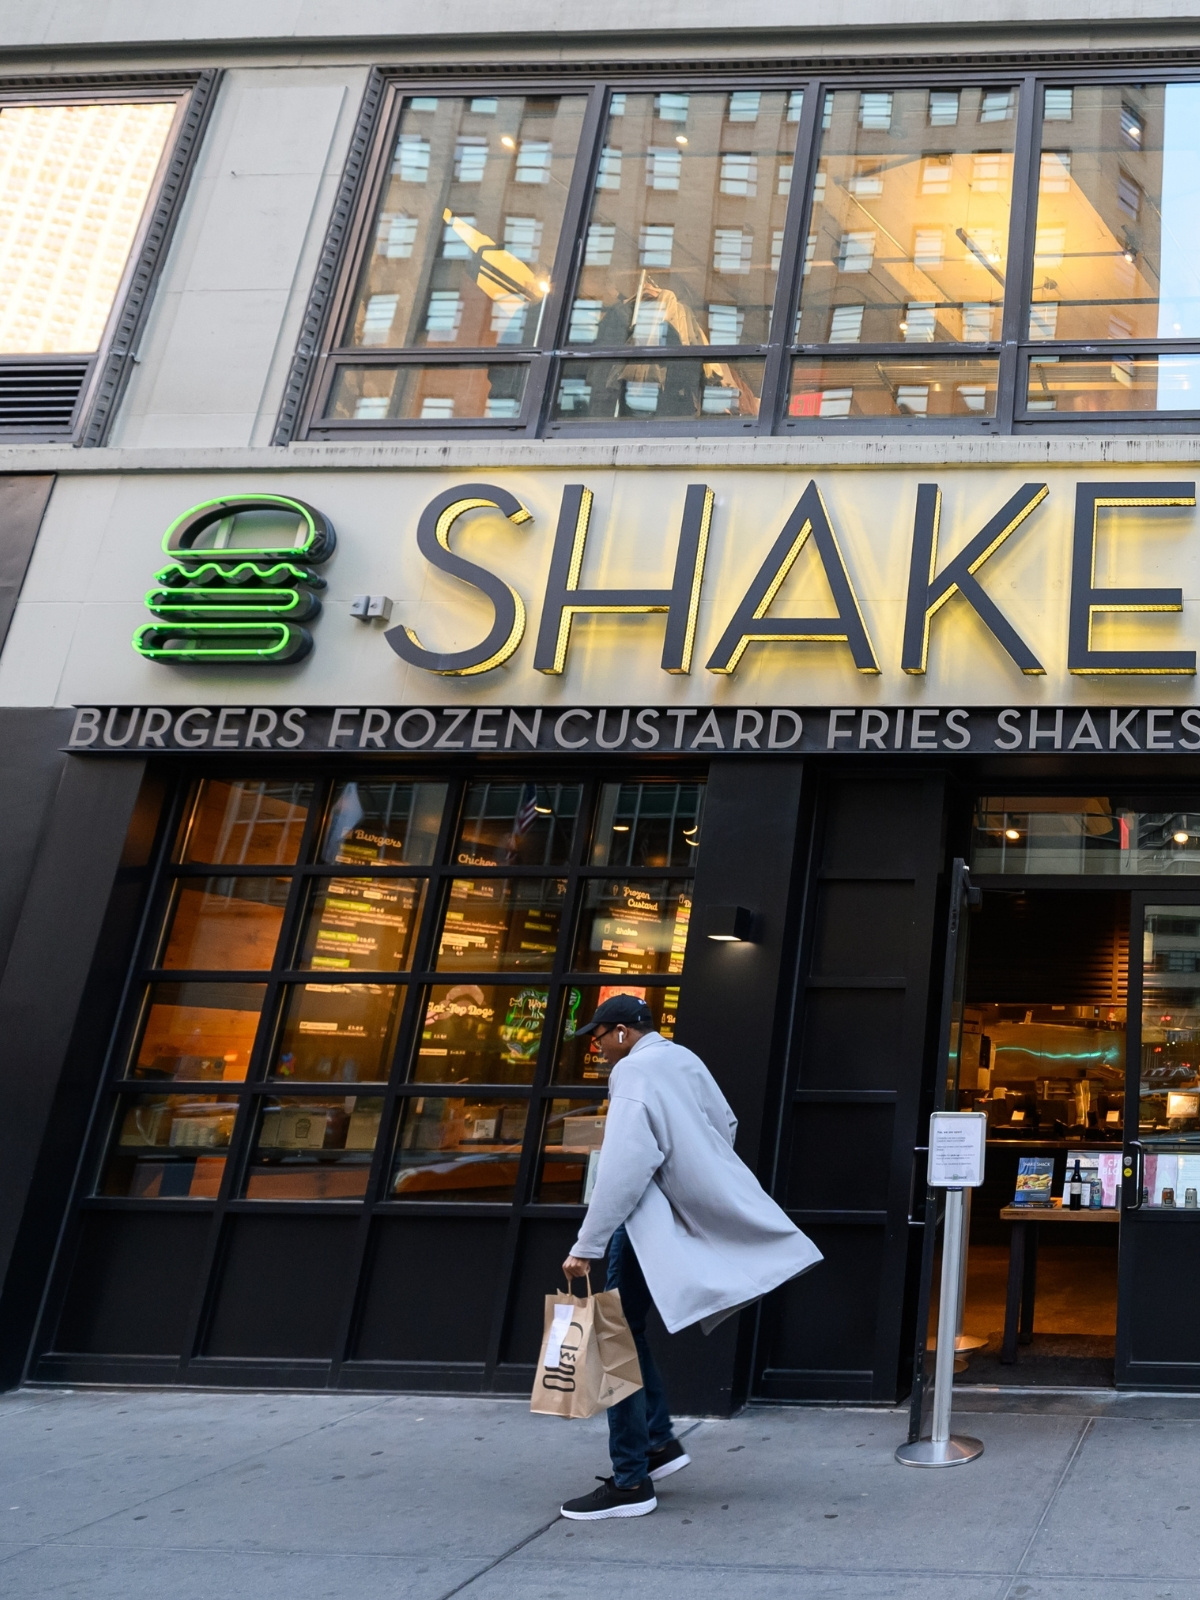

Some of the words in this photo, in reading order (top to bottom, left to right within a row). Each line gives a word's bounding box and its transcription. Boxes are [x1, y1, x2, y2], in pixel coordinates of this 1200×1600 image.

[384, 479, 1197, 677] SHAKE
[67, 706, 306, 748] BURGERS
[326, 707, 541, 748] FROZEN
[553, 707, 803, 750] CUSTARD
[826, 708, 971, 750] FRIES
[355, 829, 402, 848] Burgers
[457, 853, 497, 867] Chicken
[627, 898, 659, 911] Custard
[467, 1004, 495, 1018] Dogs
